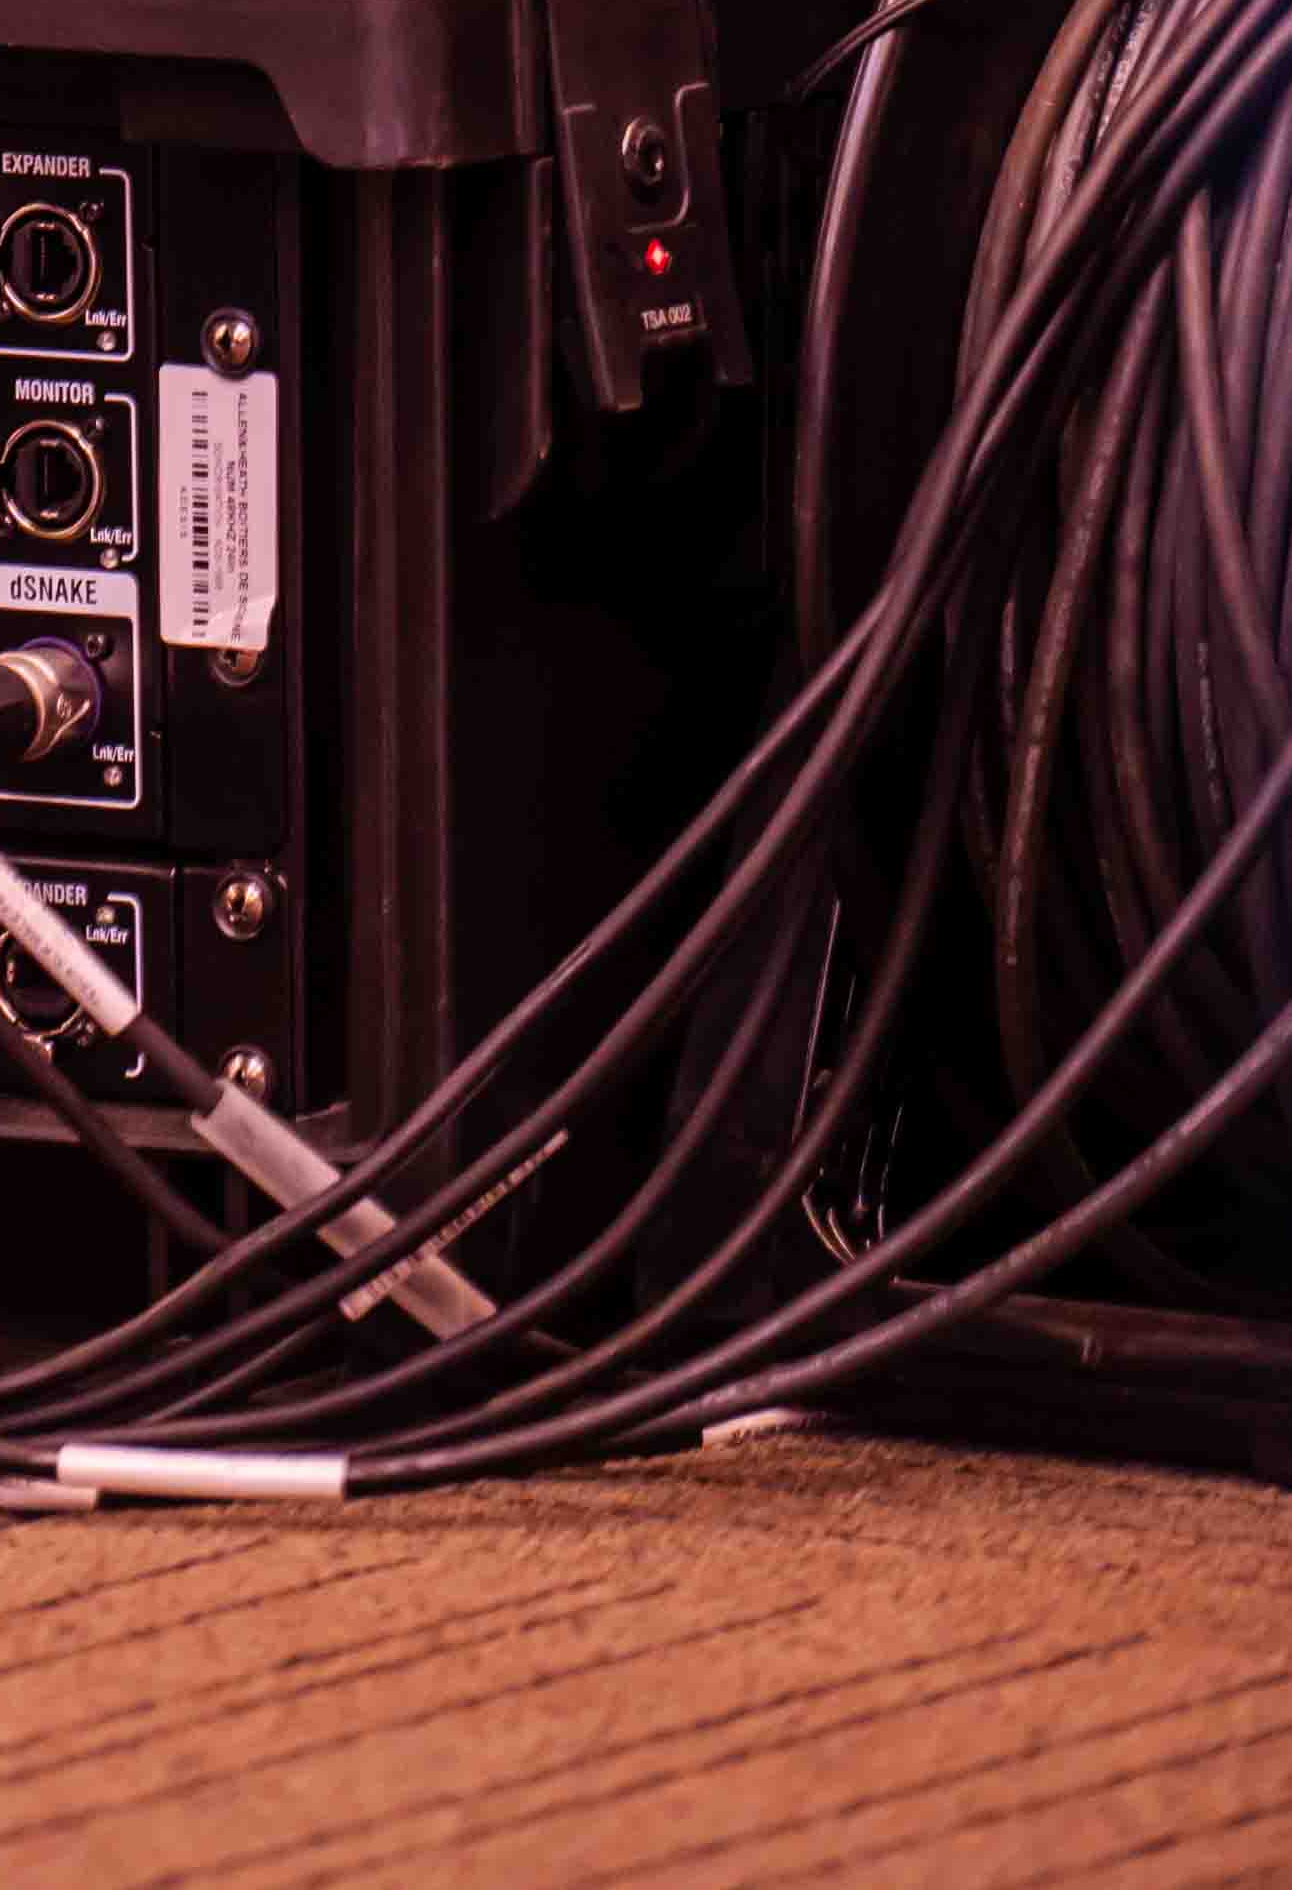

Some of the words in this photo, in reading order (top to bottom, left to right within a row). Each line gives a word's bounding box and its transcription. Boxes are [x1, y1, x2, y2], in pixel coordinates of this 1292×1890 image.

[2, 153, 90, 177] EXPANDER
[16, 379, 94, 404] MONITOR
[11, 575, 96, 604] dSNAKE
[86, 926, 128, 944] Lnk/Err
